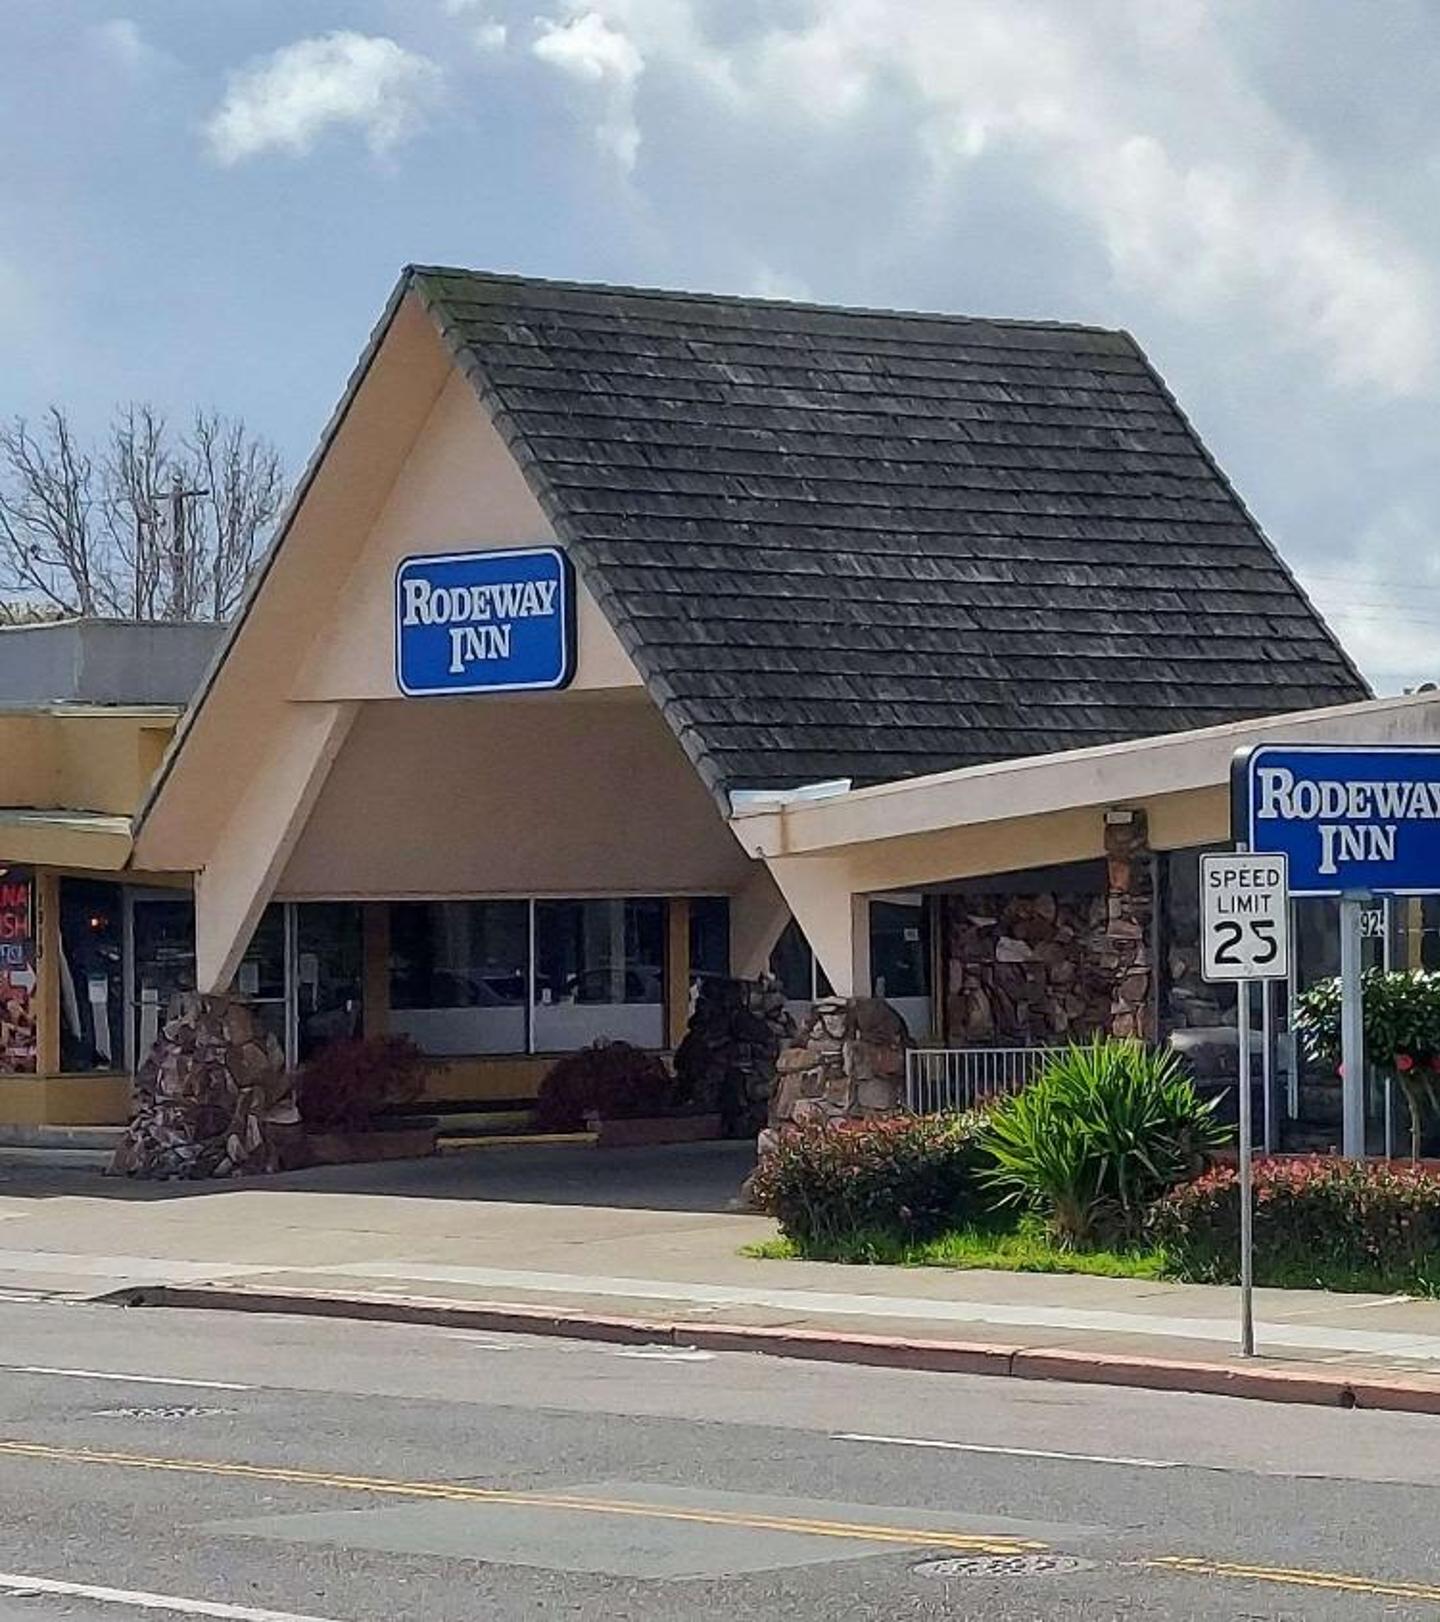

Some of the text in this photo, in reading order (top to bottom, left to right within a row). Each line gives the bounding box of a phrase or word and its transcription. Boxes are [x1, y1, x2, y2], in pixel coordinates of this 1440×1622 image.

[402, 579, 558, 626] RODEWAY
[449, 623, 512, 673] INN
[1317, 824, 1397, 875] INN
[1209, 869, 1280, 888] SPEED
[1217, 895, 1272, 914] LIMIT
[1213, 920, 1278, 965] 25
